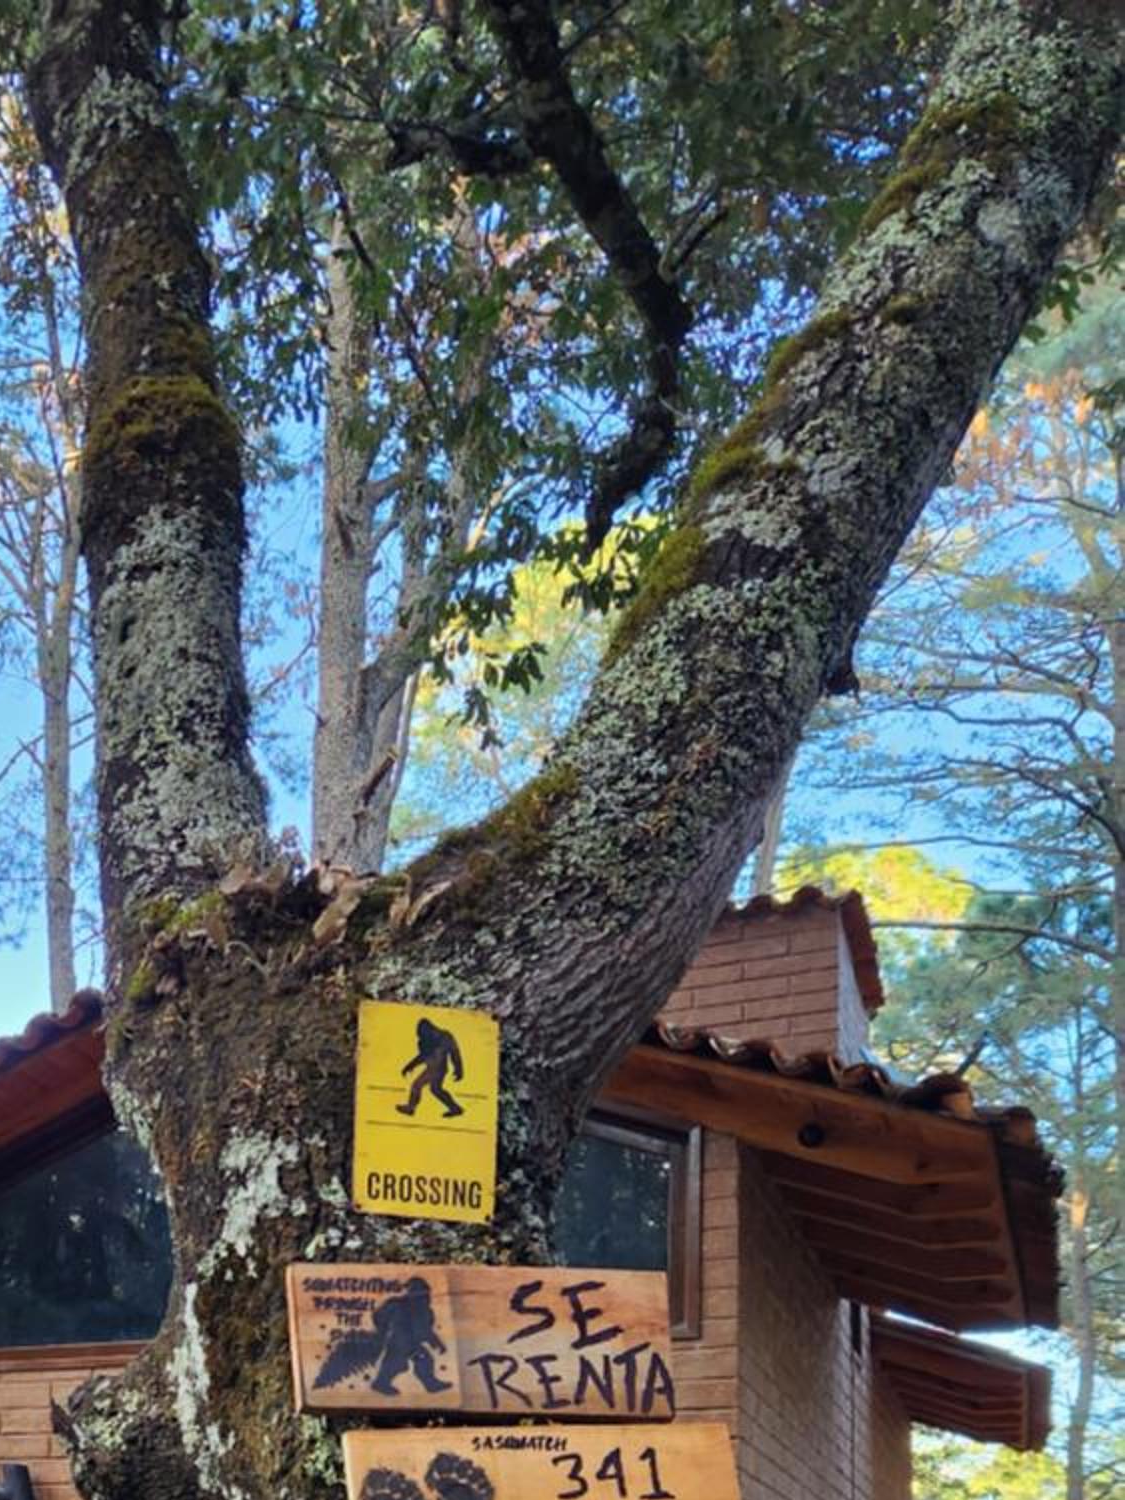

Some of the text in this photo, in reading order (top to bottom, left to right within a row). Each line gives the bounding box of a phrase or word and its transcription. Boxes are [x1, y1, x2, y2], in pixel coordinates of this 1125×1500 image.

[366, 1171, 483, 1209] CROSSING
[506, 1279, 625, 1350] SE
[467, 1342, 676, 1416] RENTA
[552, 1446, 676, 1500] 341
